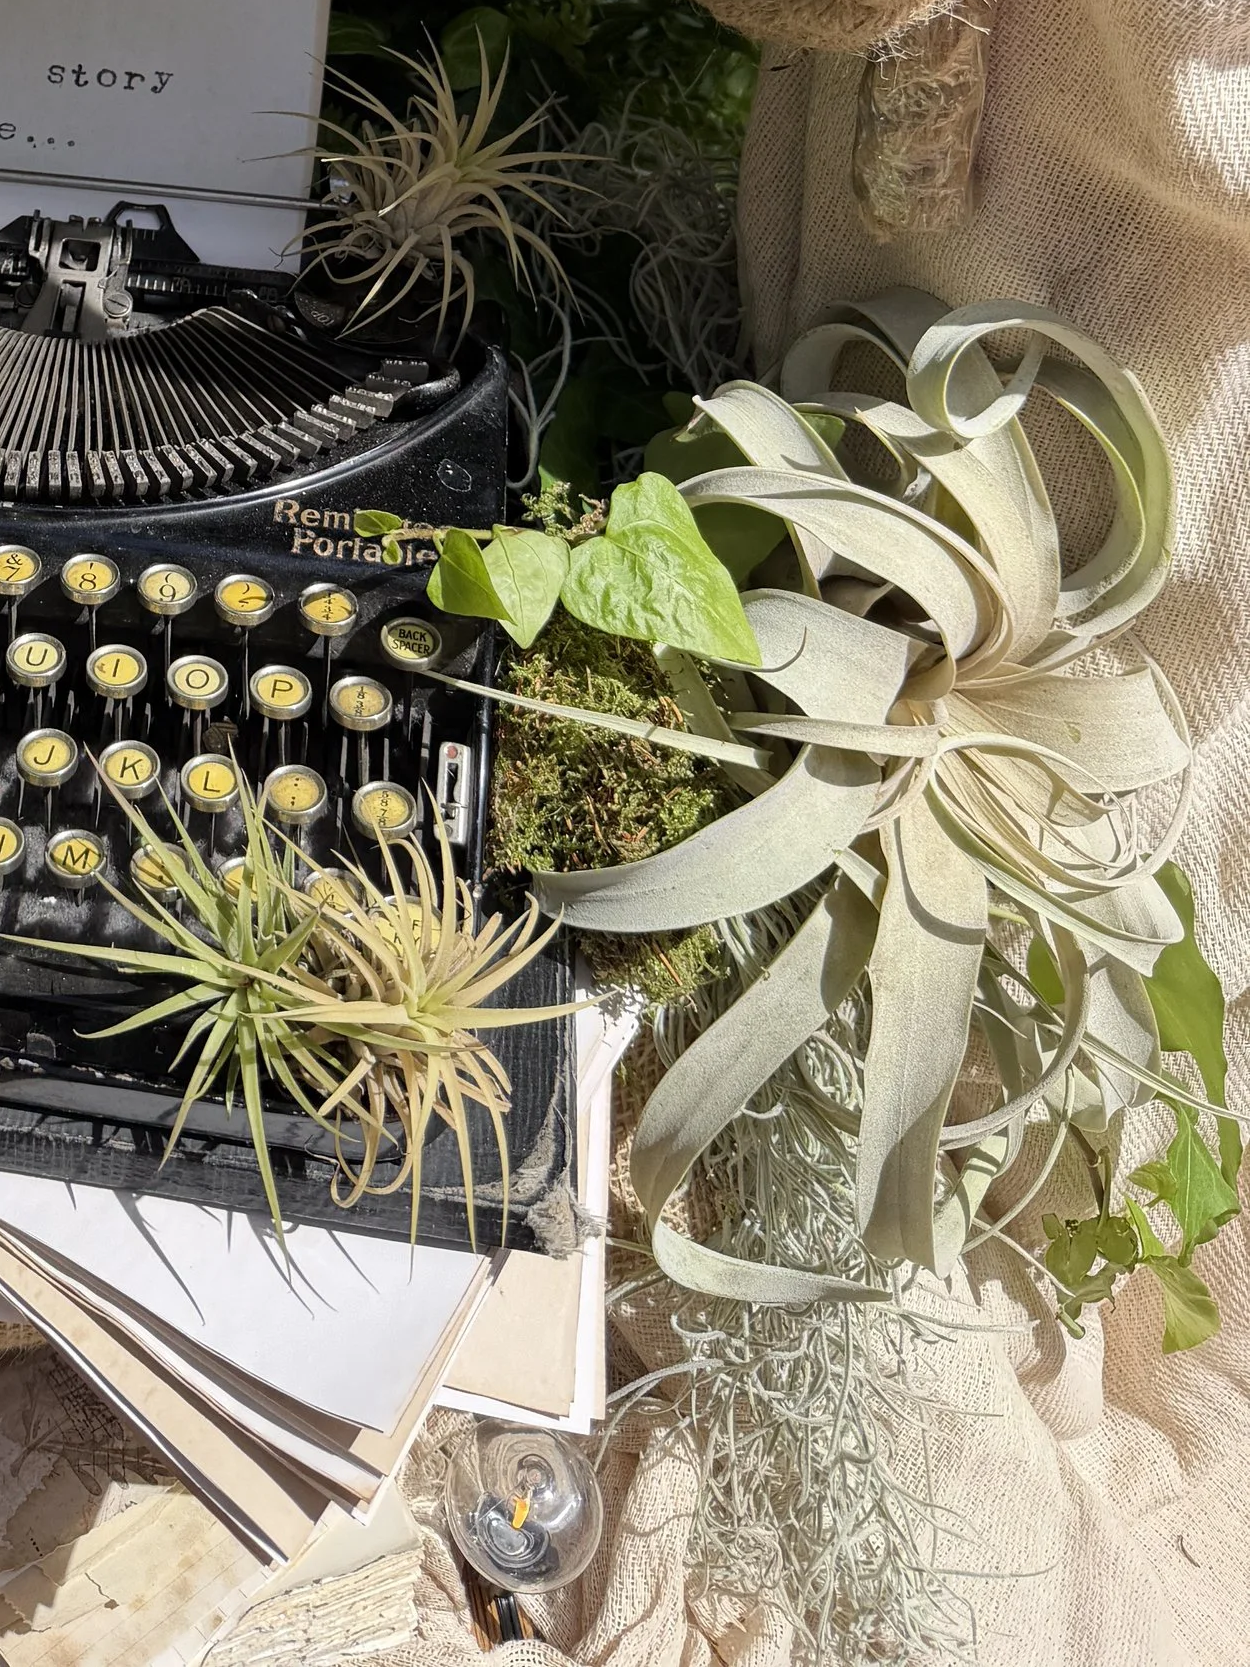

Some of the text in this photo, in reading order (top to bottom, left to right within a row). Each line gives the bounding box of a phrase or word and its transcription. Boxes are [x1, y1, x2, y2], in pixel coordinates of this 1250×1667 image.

[47, 63, 174, 94] story
[290, 527, 439, 568] Portale
[79, 572, 98, 591] 8
[158, 582, 178, 602] 9
[398, 628, 427, 642] BACK
[25, 646, 49, 667] U
[391, 639, 431, 655] SPACER
[185, 669, 210, 690] O
[271, 679, 293, 699] P
[33, 745, 56, 766] J
[119, 756, 143, 781] K
[202, 770, 222, 793] L
[63, 844, 92, 869] M
